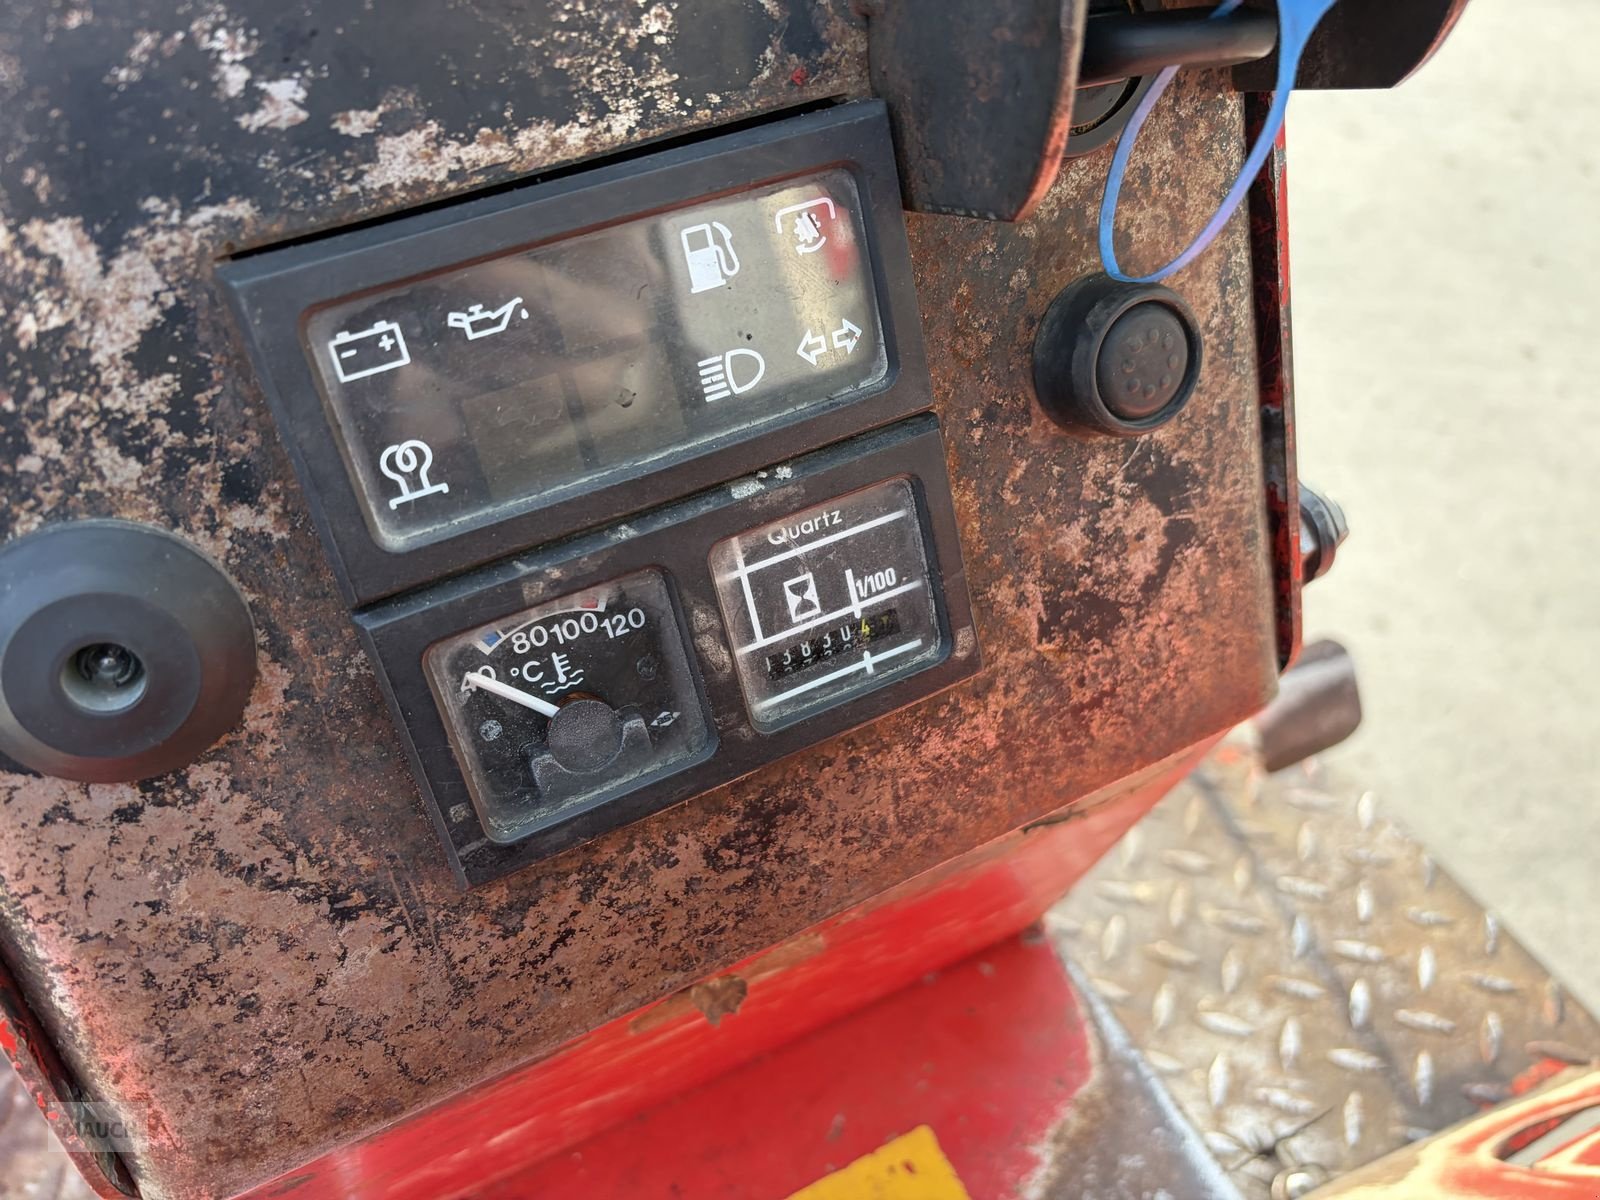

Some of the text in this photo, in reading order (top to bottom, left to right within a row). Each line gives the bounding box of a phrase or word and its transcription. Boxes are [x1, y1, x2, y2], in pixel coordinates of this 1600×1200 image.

[767, 510, 842, 545] Quartz
[855, 568, 897, 598] 1/100
[511, 625, 549, 654] 80
[550, 612, 598, 645] 100
[600, 608, 646, 639] 120
[510, 660, 544, 682] °C
